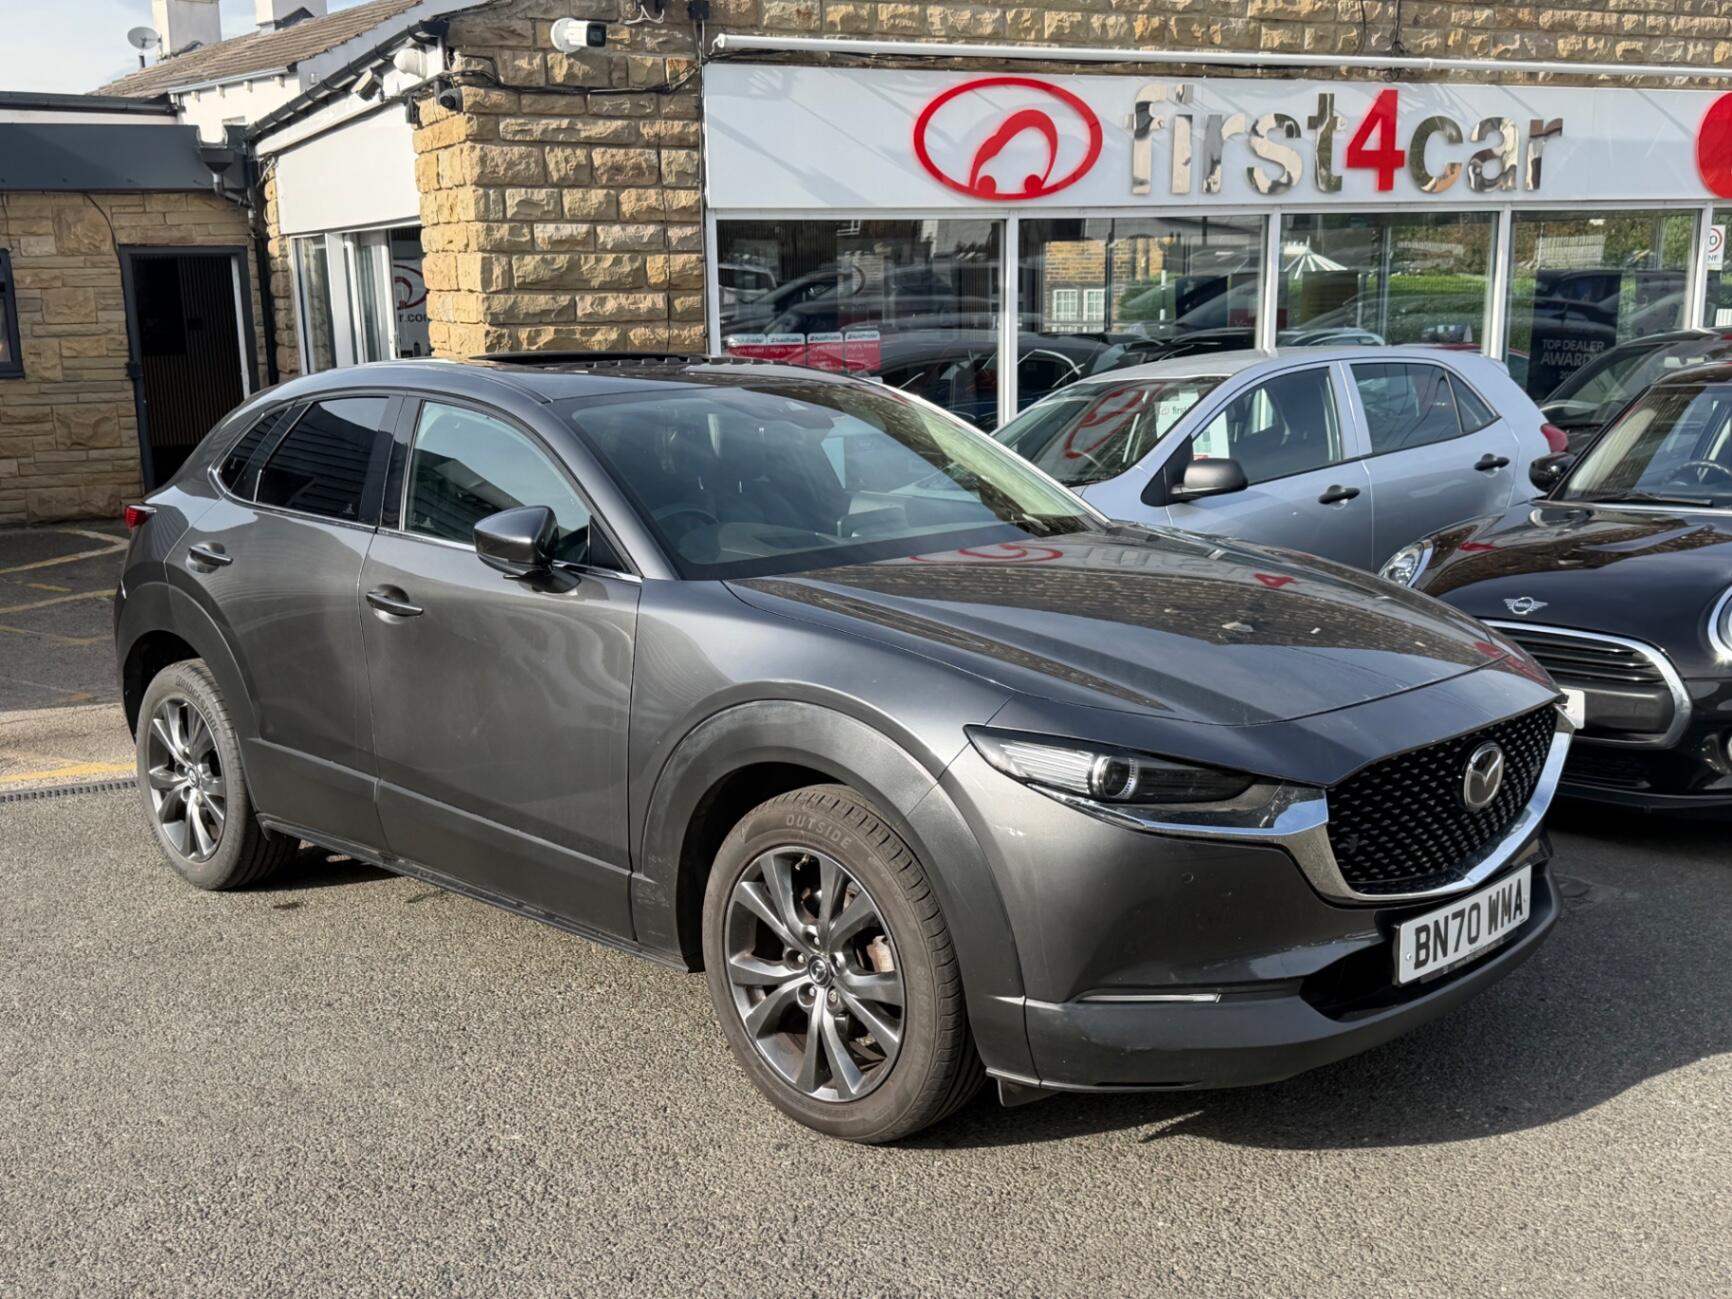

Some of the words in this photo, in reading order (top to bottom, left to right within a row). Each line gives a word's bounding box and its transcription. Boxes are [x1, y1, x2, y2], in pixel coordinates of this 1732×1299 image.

[1123, 83, 1563, 196] first4car
[1540, 351, 1597, 366] AWARD
[1541, 339, 1561, 350] TOP
[1562, 340, 1605, 352] DEALER
[786, 814, 852, 849] OUTSIDE
[1413, 902, 1481, 970] BN70
[1487, 878, 1523, 936] WMA
